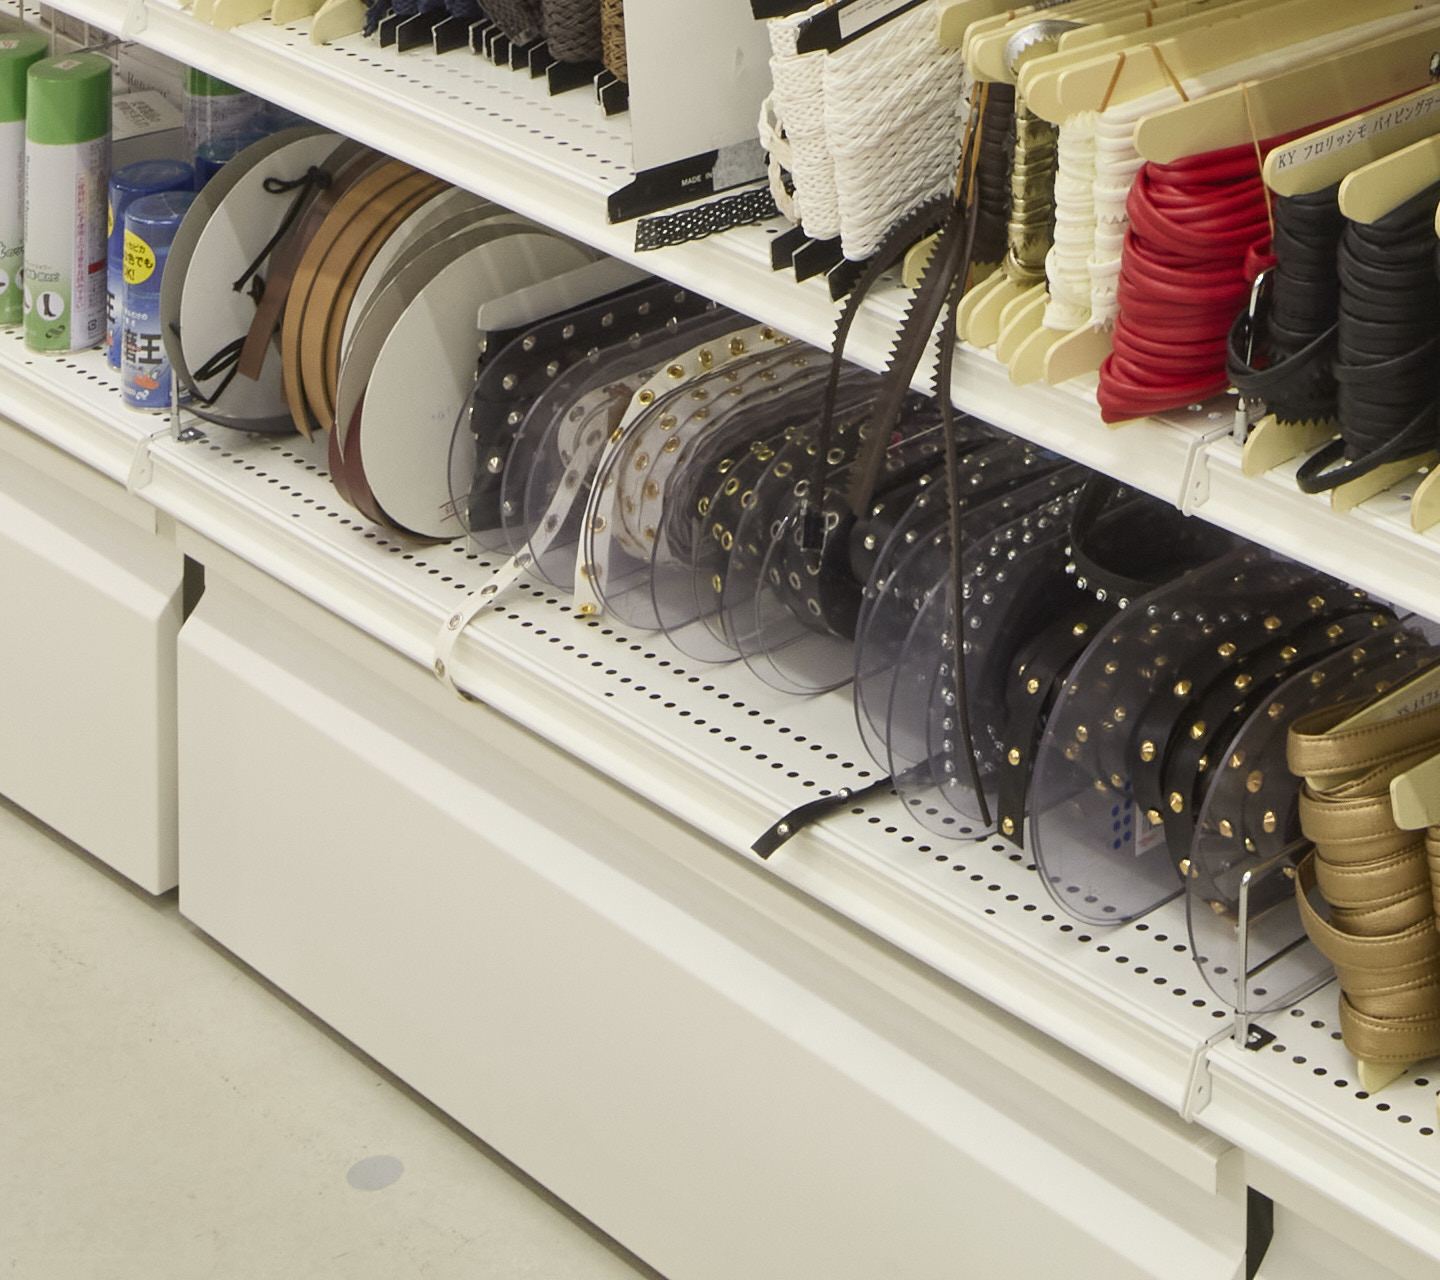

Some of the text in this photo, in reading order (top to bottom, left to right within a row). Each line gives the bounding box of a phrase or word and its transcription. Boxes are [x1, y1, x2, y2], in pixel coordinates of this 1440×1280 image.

[1277, 148, 1297, 169] KY
[1301, 124, 1368, 164] フロリッシモ
[681, 171, 713, 187] MADE IN
